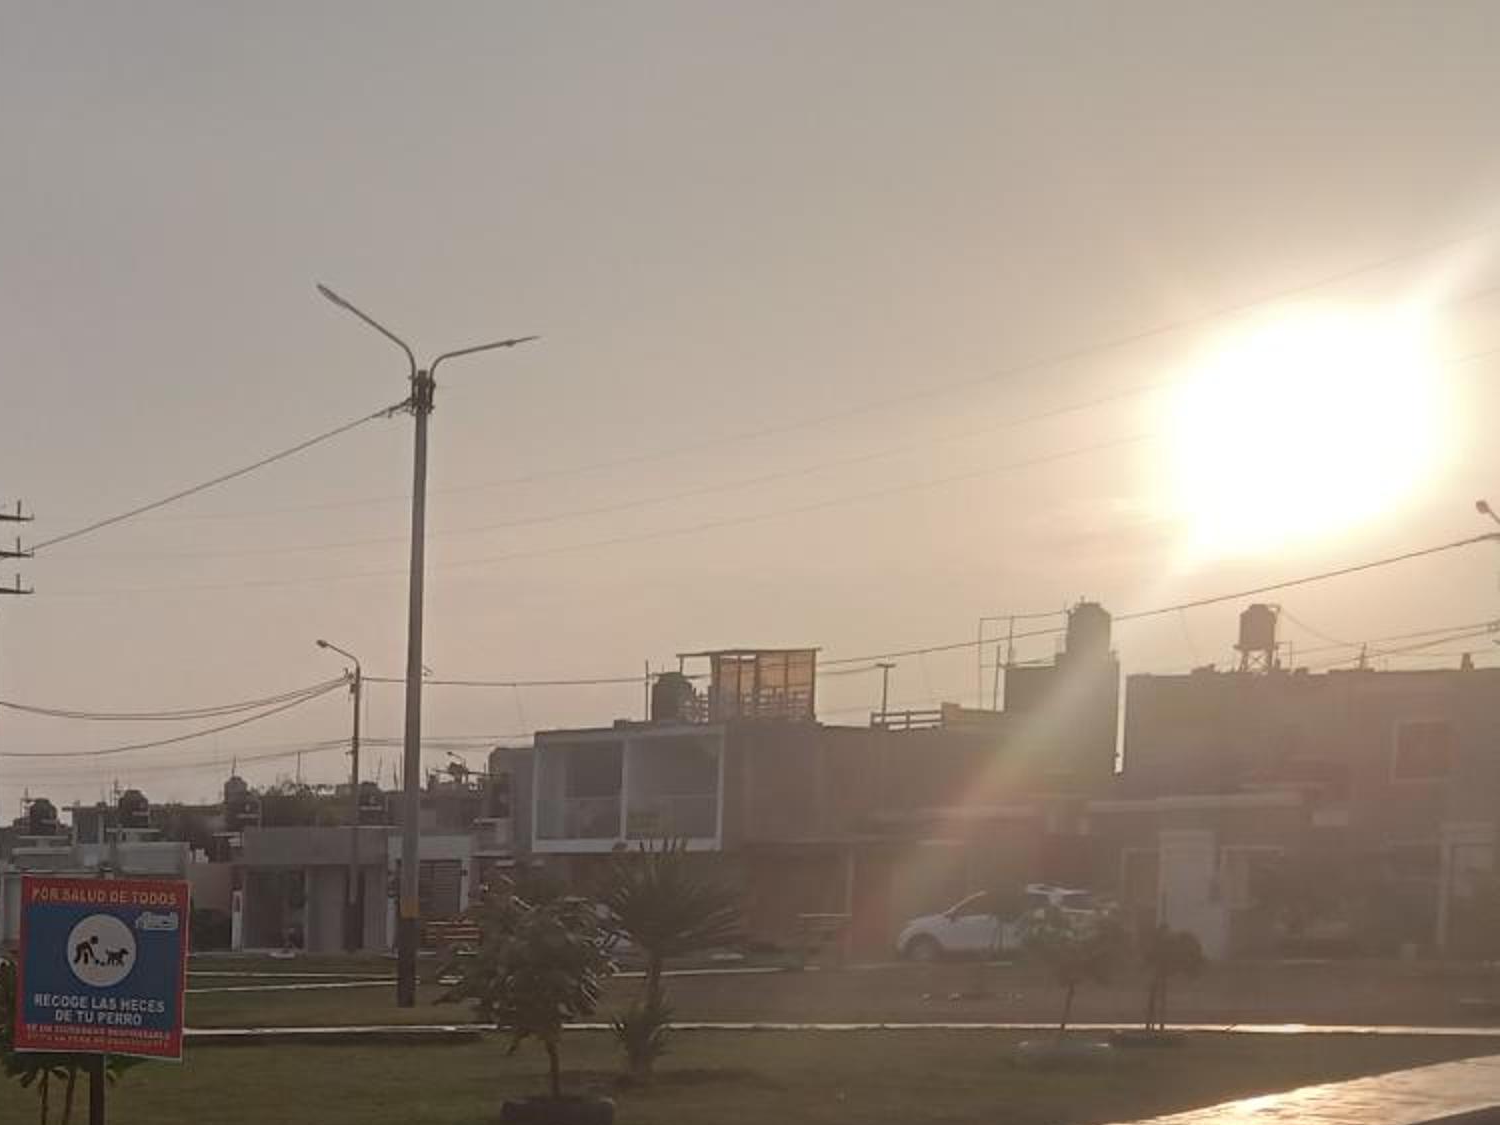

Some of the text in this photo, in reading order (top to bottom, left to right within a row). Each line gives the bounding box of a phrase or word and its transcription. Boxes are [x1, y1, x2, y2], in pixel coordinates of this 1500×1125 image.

[61, 888, 105, 902] SALUD
[110, 890, 130, 902] DE
[132, 891, 178, 905] TODOS
[34, 993, 165, 1013] RECOGE LAS HECES
[55, 1009, 142, 1025] DE TU PERRO
